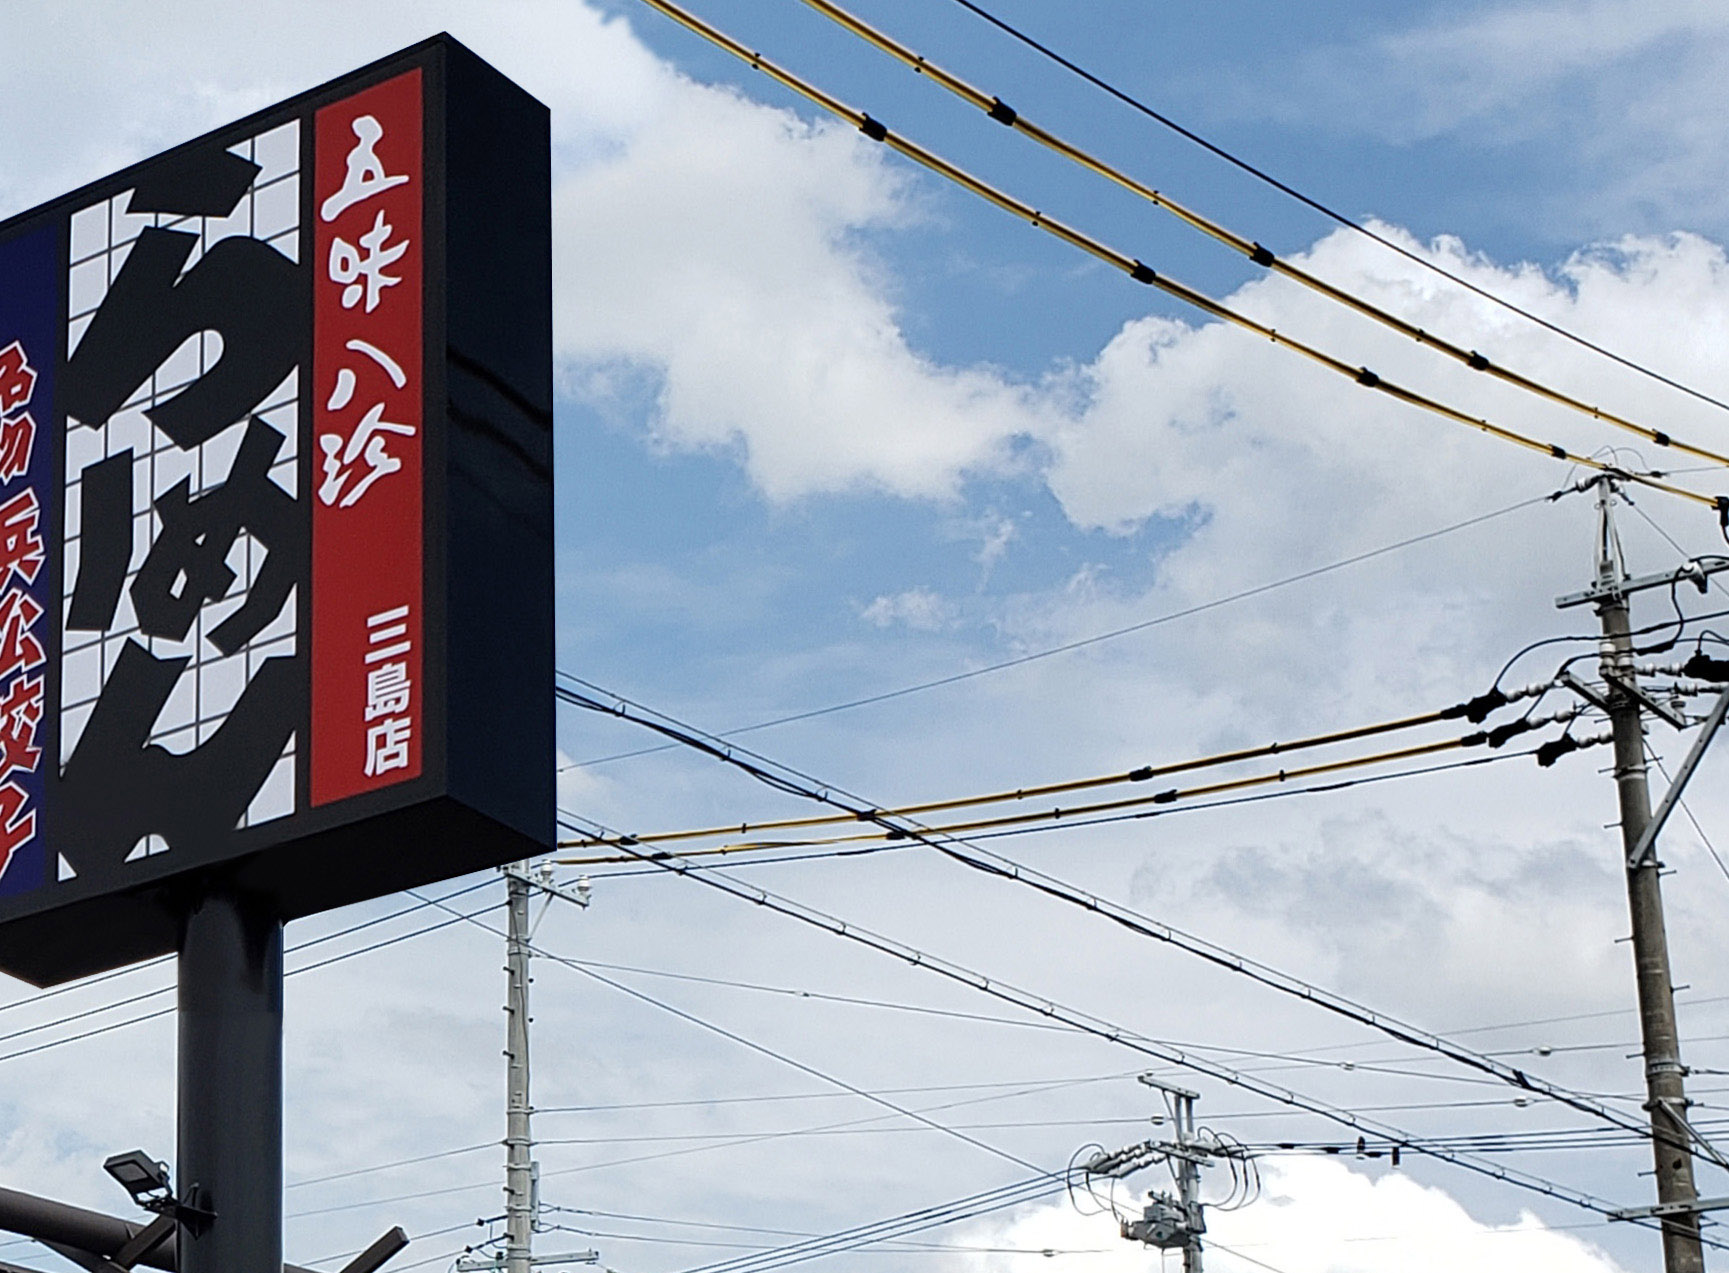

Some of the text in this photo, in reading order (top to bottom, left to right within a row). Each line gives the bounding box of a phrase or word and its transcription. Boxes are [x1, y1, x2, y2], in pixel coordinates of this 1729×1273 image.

[319, 114, 416, 509] 五味八珍
[363, 604, 411, 778] 三島店
